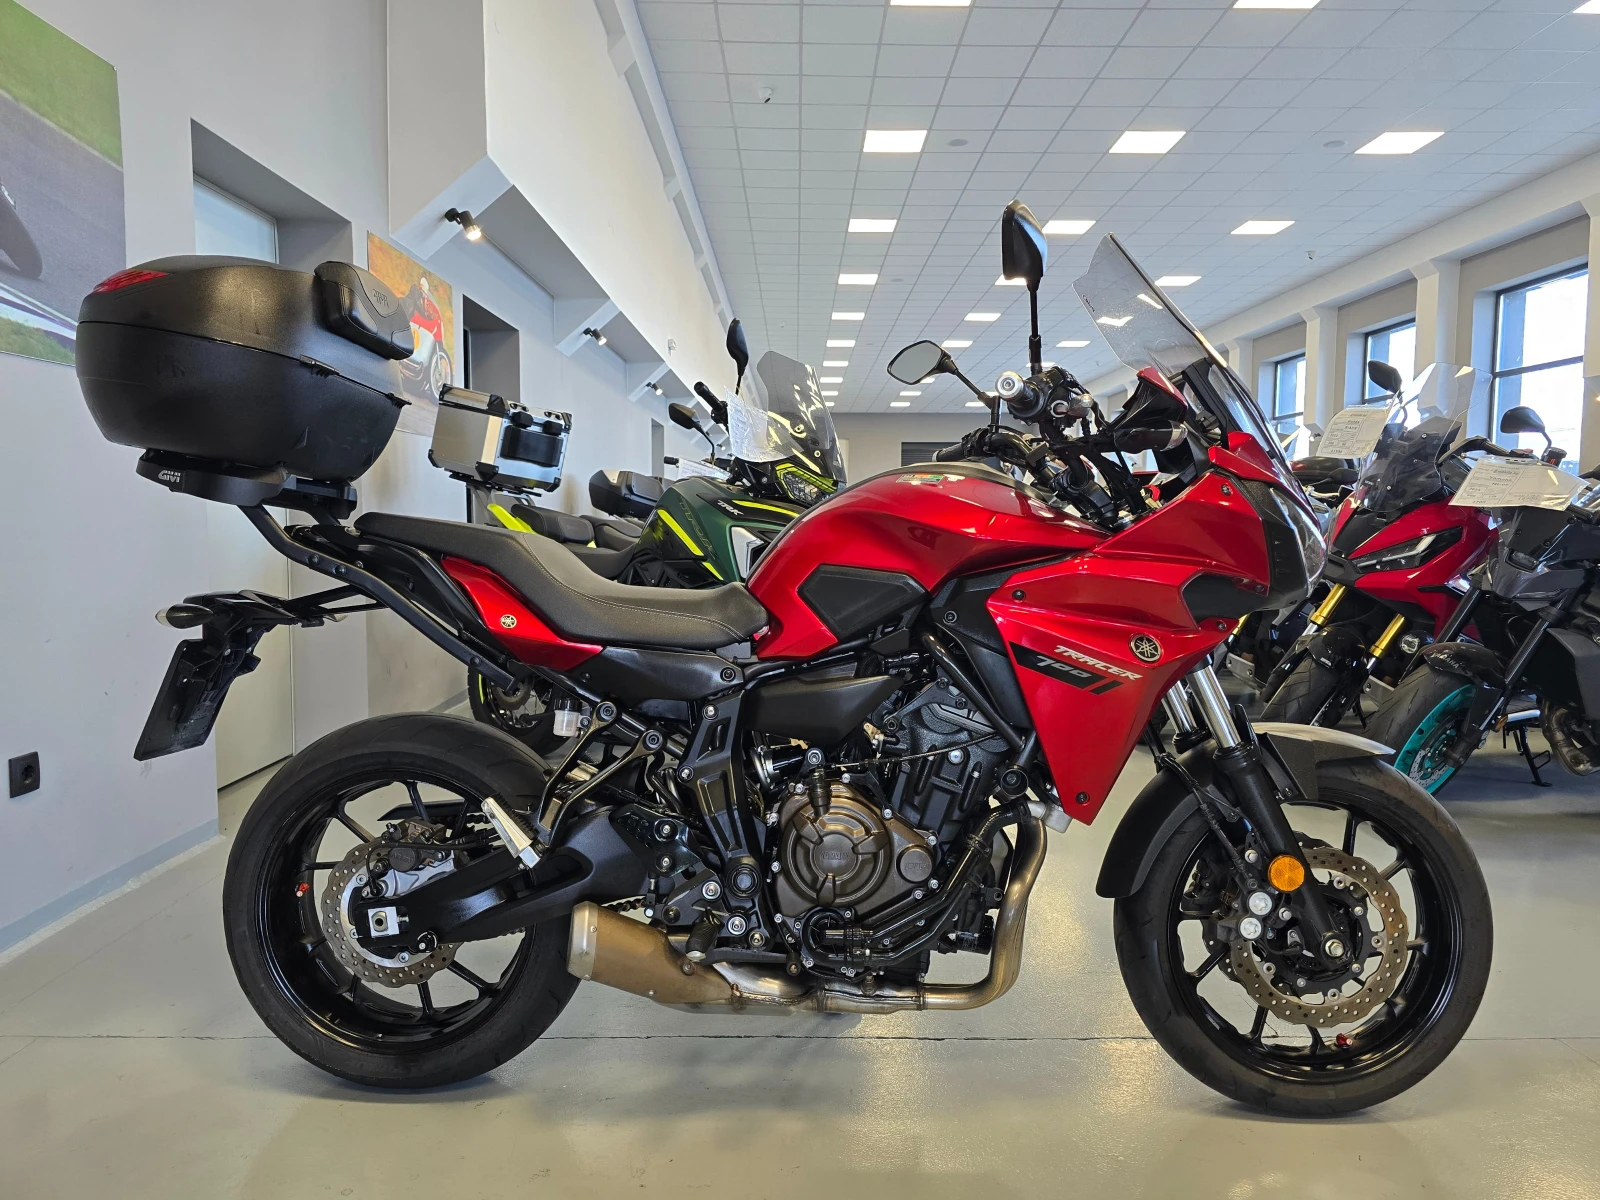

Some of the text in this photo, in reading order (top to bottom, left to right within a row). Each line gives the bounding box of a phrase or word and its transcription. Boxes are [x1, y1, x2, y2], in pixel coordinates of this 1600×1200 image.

[158, 470, 181, 483] GIVI
[717, 499, 744, 516] TRK
[1036, 655, 1093, 678] 700
[1054, 645, 1143, 680] TRACER
